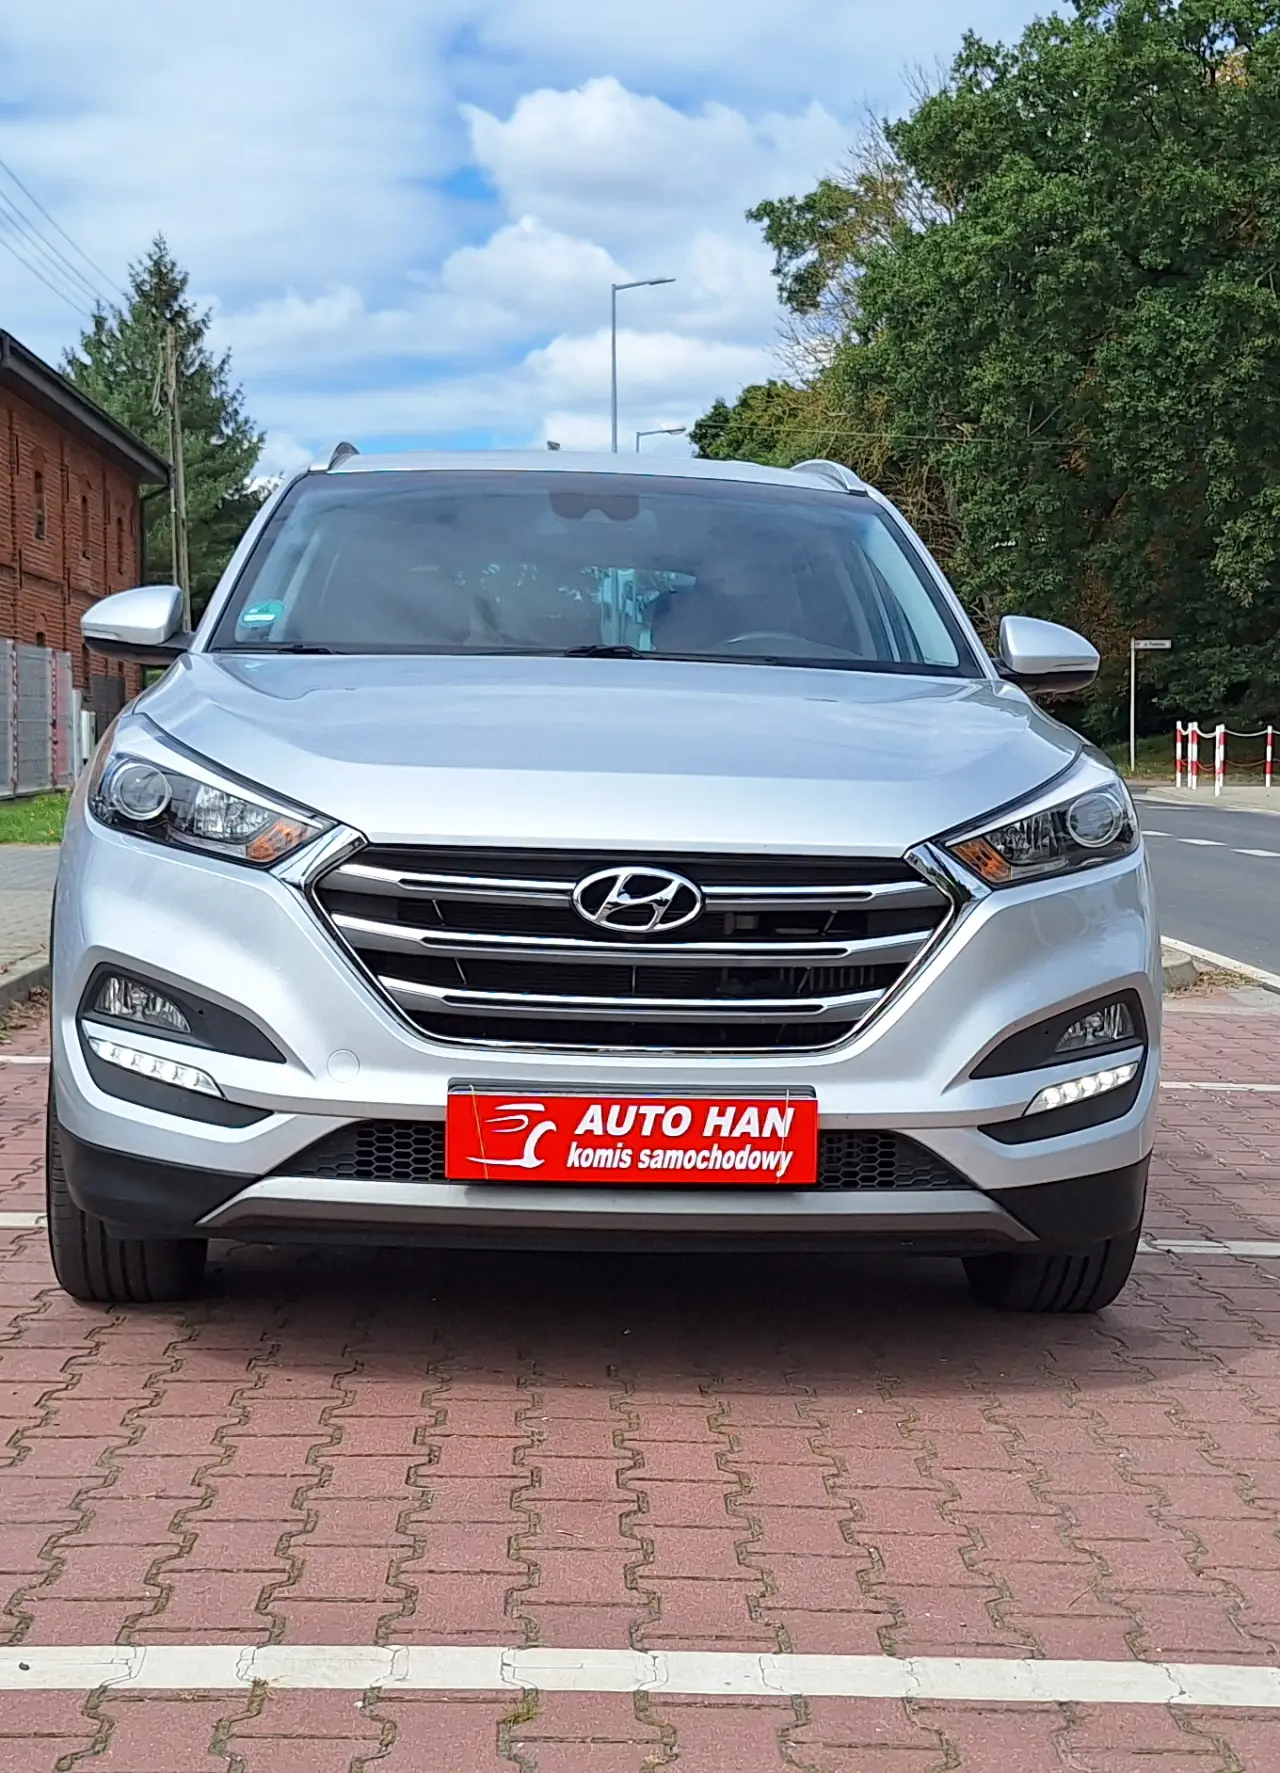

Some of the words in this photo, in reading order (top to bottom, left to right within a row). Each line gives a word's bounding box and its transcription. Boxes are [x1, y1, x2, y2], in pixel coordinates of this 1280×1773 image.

[574, 1104, 692, 1138] AUTO
[702, 1107, 795, 1139] HAN
[566, 1141, 632, 1168] komis
[637, 1143, 793, 1177] samochodowy
